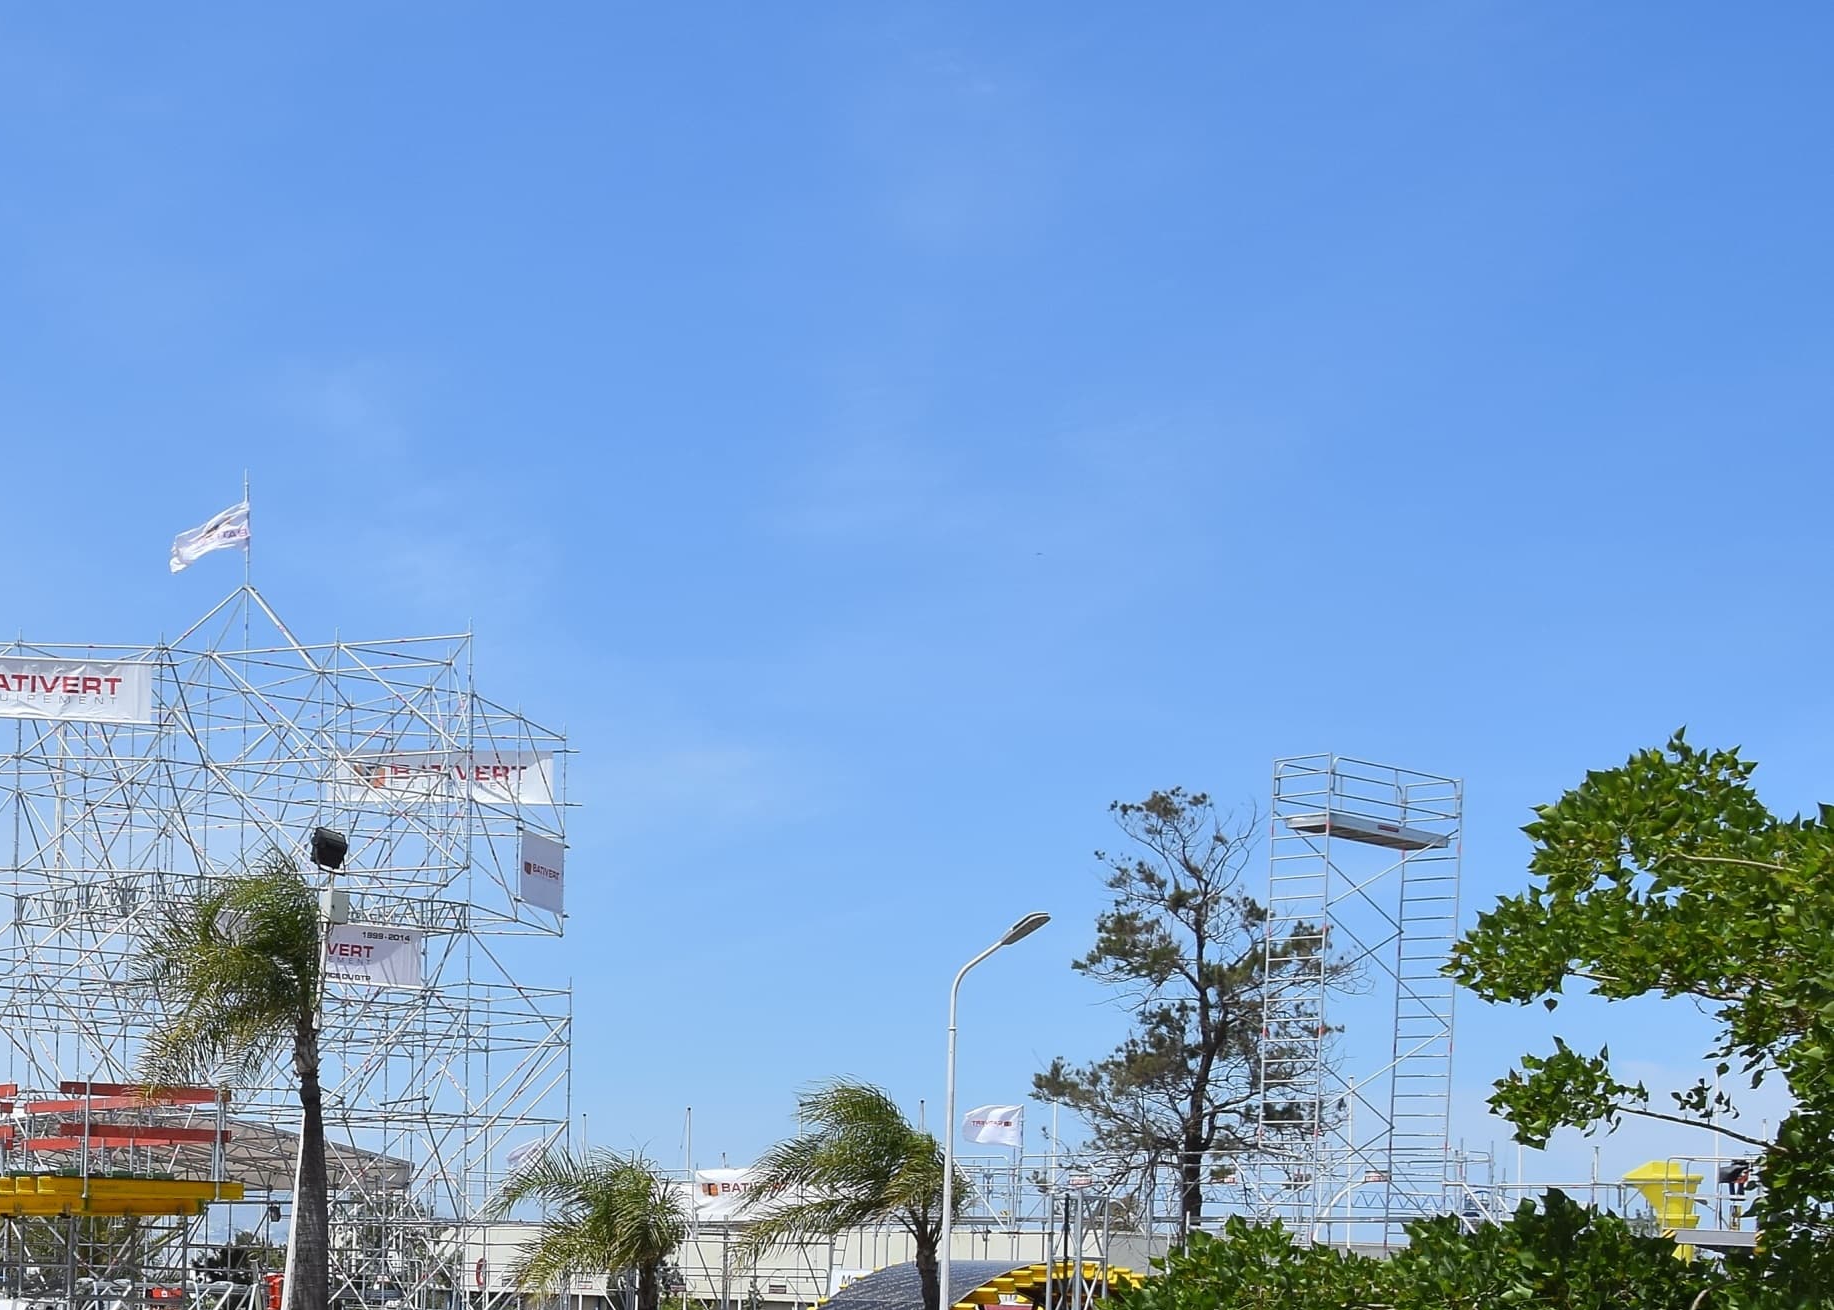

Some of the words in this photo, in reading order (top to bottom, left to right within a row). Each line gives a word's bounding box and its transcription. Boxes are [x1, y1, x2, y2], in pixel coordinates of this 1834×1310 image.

[391, 765, 527, 781] BATIVERT
[532, 863, 560, 880] BATIVERT
[328, 943, 375, 958] VERT
